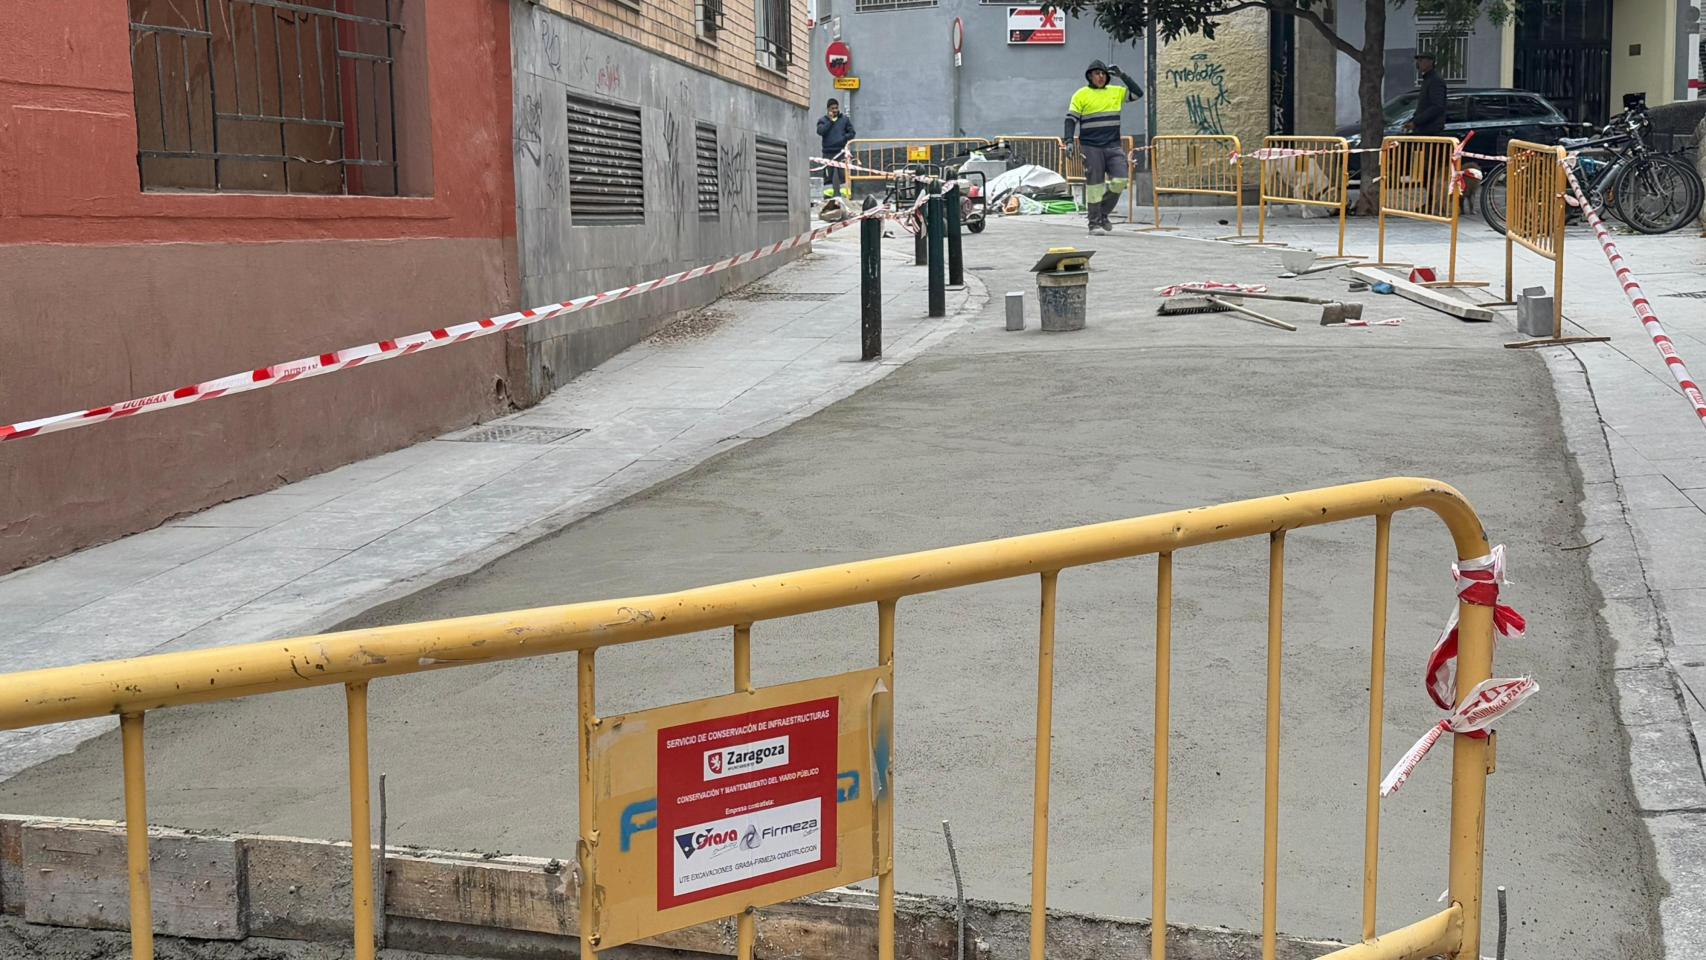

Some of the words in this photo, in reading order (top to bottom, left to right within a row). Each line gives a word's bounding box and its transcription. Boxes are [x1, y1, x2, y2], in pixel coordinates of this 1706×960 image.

[666, 736, 697, 749] SERVICIO
[697, 733, 707, 743] DE
[708, 723, 757, 741] CONSERVACIÓN
[758, 721, 768, 731] DE
[768, 710, 830, 730] INFRAESTRUCTURAS
[727, 744, 785, 764] Zaragoza
[677, 788, 719, 805] CONSERVACIÓN
[720, 787, 725, 795] Y
[725, 777, 768, 794] MANTENIMIENTO
[768, 776, 778, 785] DEL
[779, 772, 797, 782] VIARIO
[797, 767, 820, 778] PÚBLICO
[725, 804, 747, 815] Empresa
[696, 828, 738, 850] Grasa
[762, 819, 818, 839] Firmeza
[679, 874, 690, 884] UTE
[691, 864, 733, 881] EXCAVACIONES
[734, 854, 776, 870] GRASA-FIRMEZA
